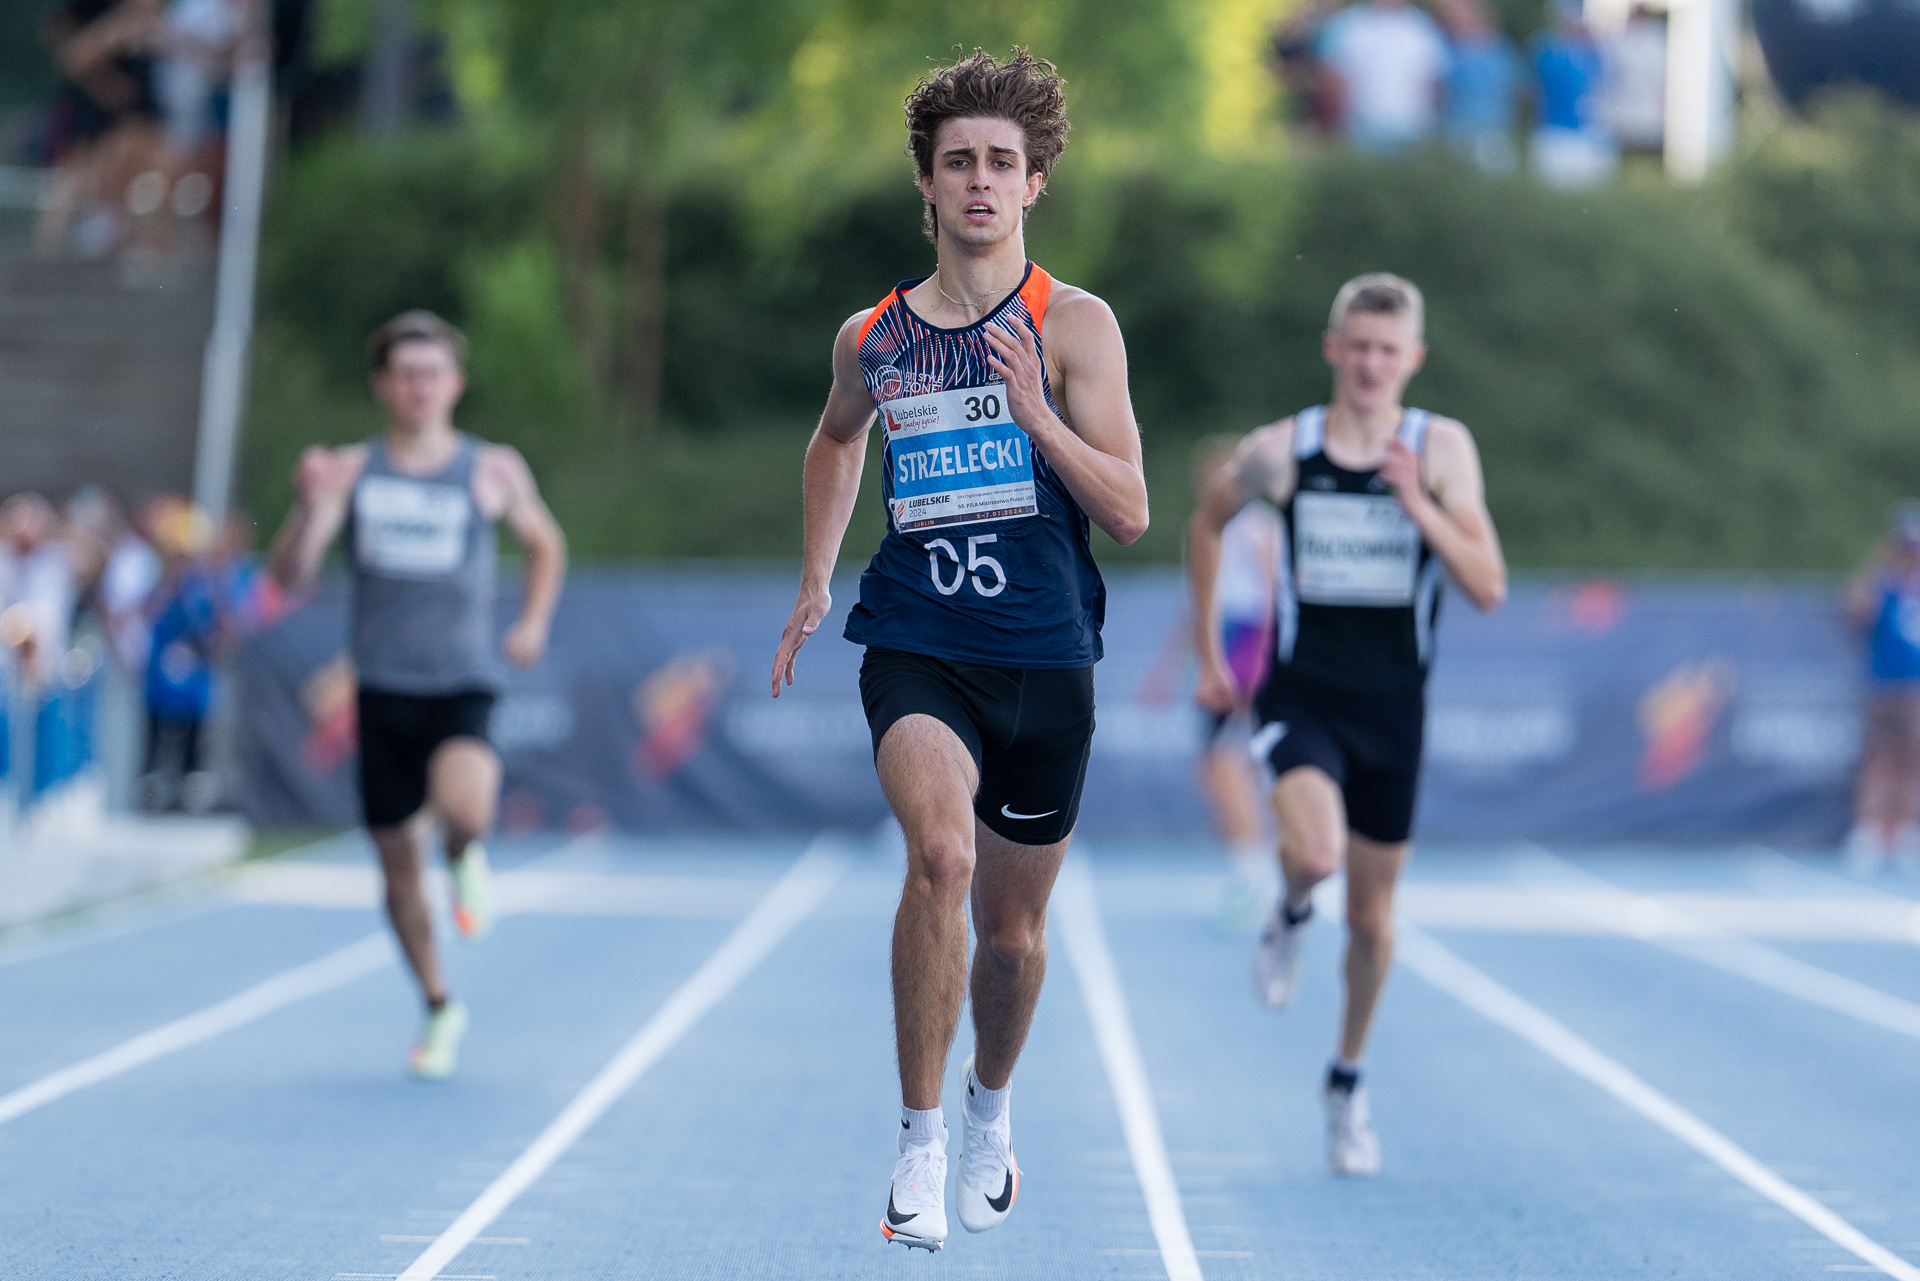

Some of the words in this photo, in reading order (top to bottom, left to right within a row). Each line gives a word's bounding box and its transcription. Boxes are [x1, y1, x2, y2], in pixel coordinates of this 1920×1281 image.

[904, 382, 942, 394] ZONE
[964, 394, 1001, 422] 30
[898, 437, 1023, 484] STRZELECKI
[909, 495, 951, 509] LUBELSKIE
[909, 508, 927, 518] 2024
[976, 507, 1023, 520] 5-7.07.2024
[913, 519, 935, 529] LUBLIN
[924, 533, 1007, 598] 05
